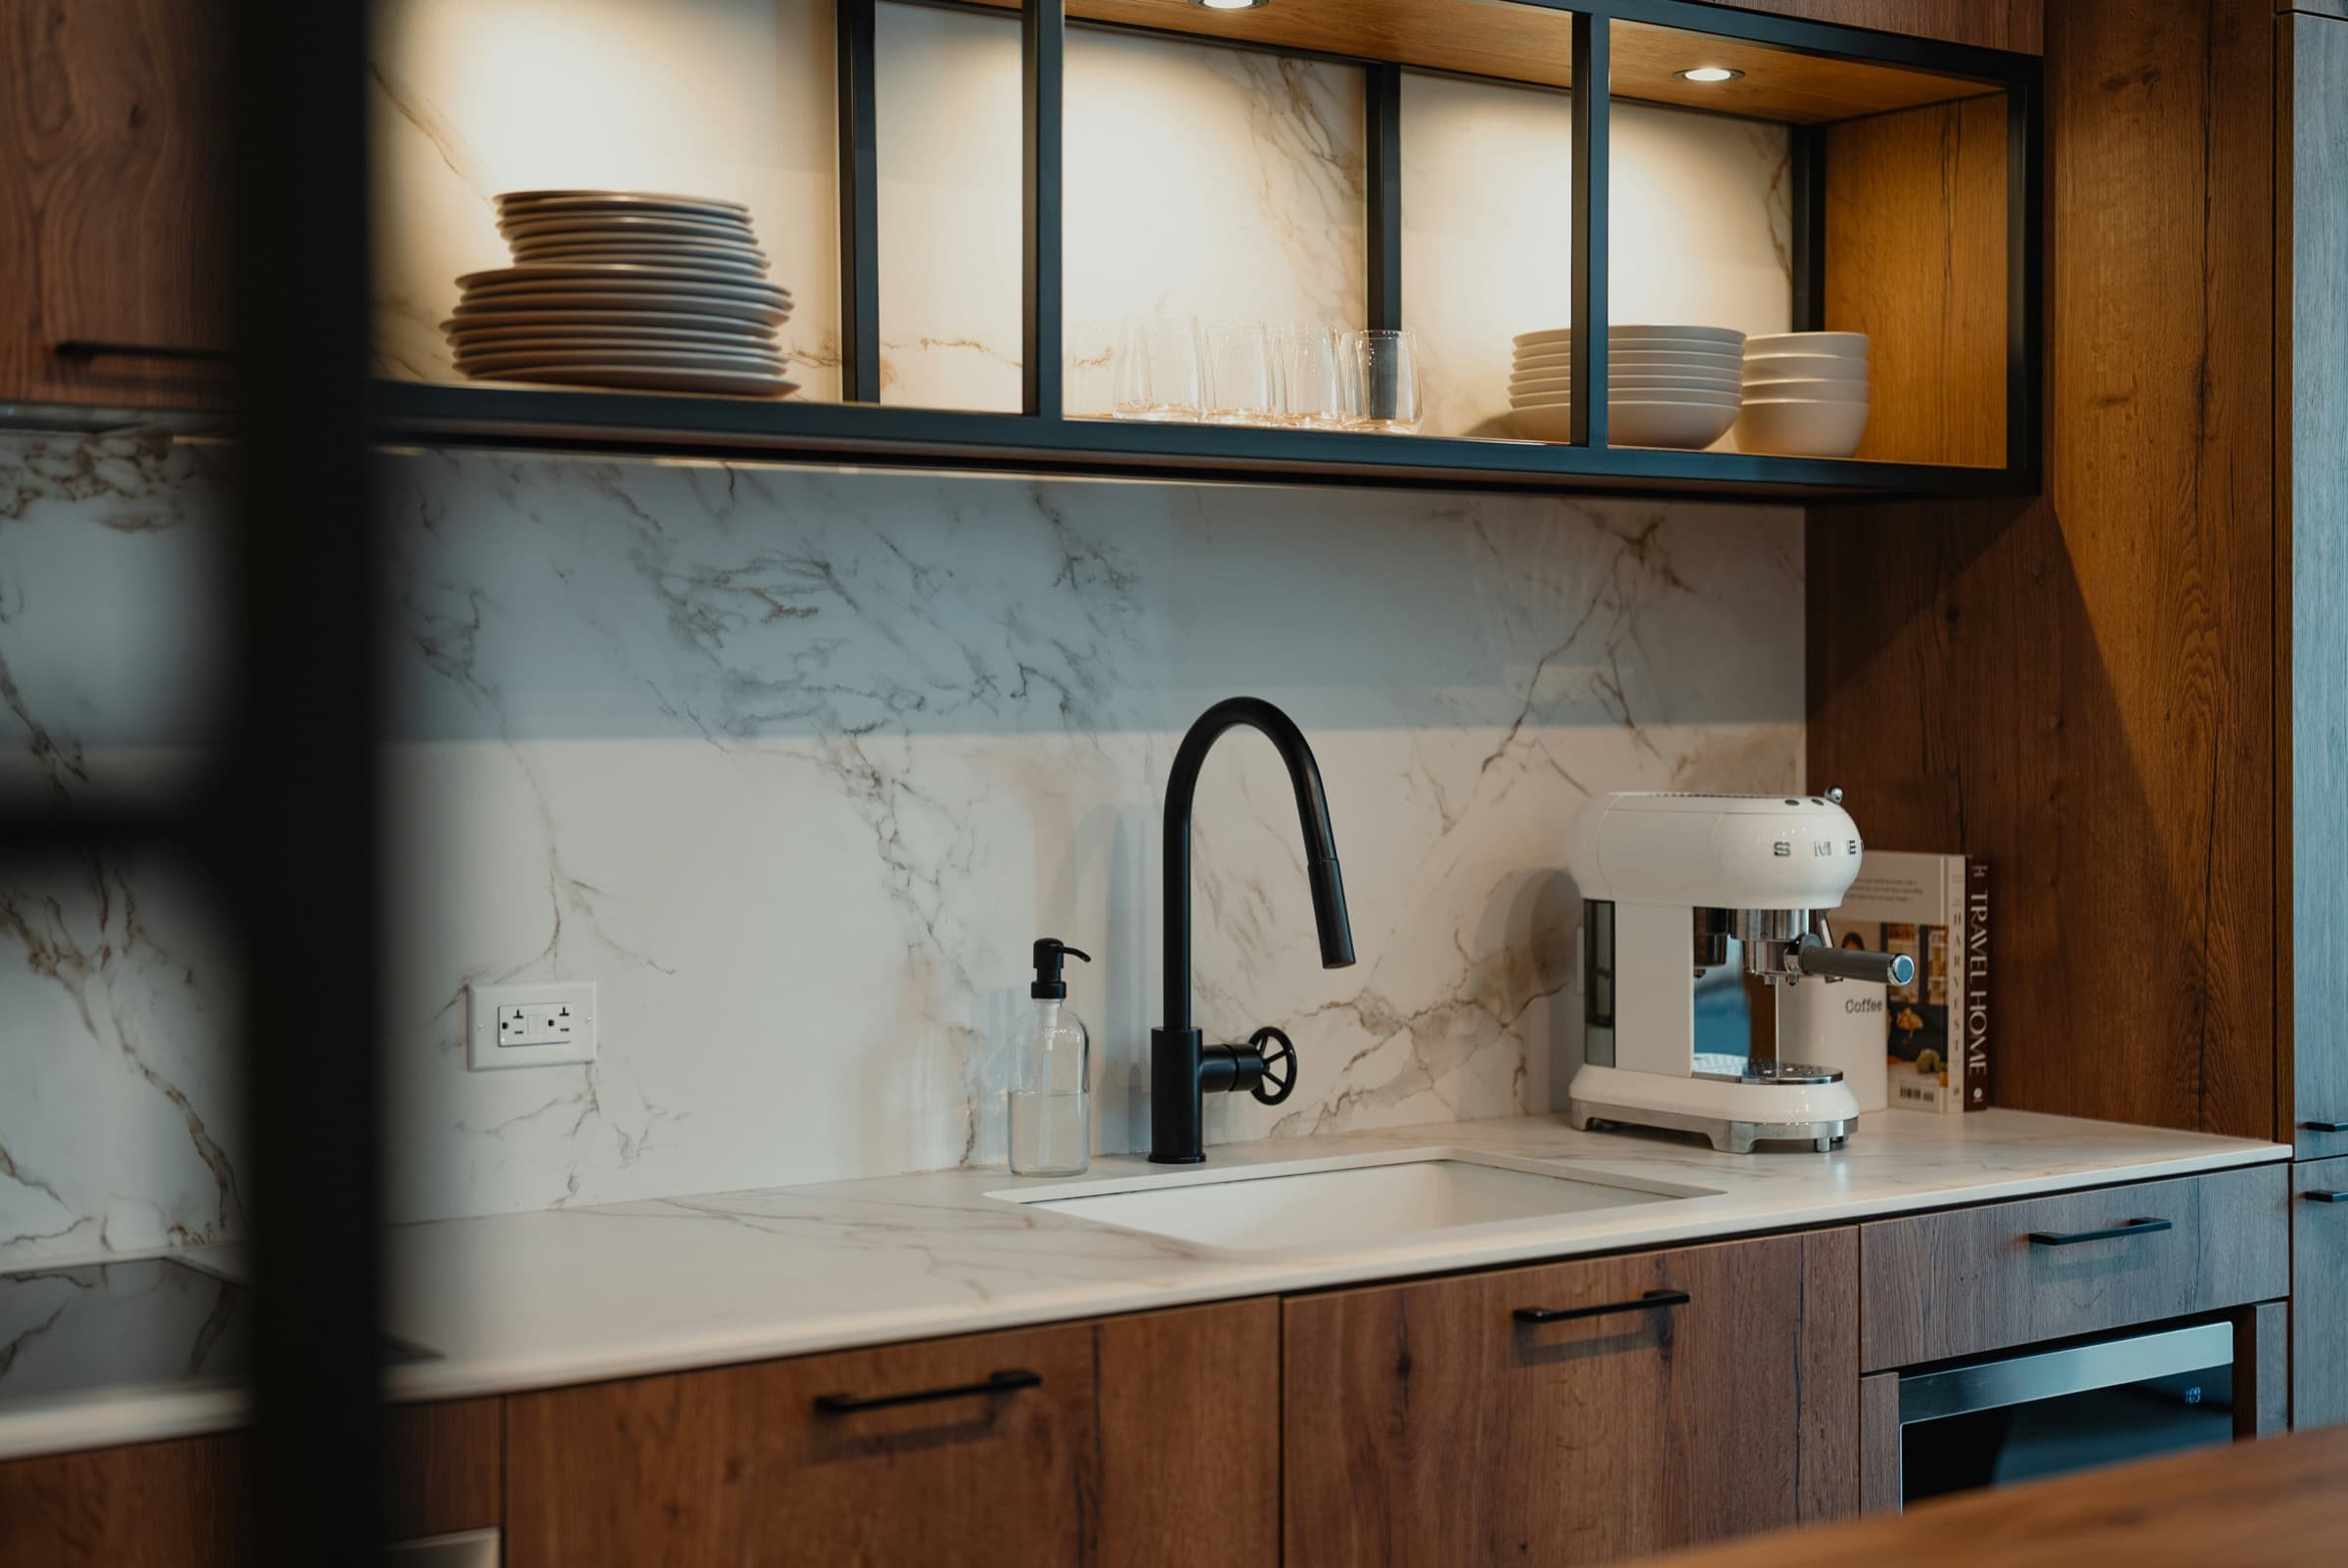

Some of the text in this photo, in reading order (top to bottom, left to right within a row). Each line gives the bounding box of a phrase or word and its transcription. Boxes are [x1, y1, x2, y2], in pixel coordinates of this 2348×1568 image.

[1773, 839, 1864, 857] SME
[1969, 890, 1988, 984] TRAVEL
[1845, 998, 1882, 1013] Coffee
[1969, 990, 1987, 1076] HOME
